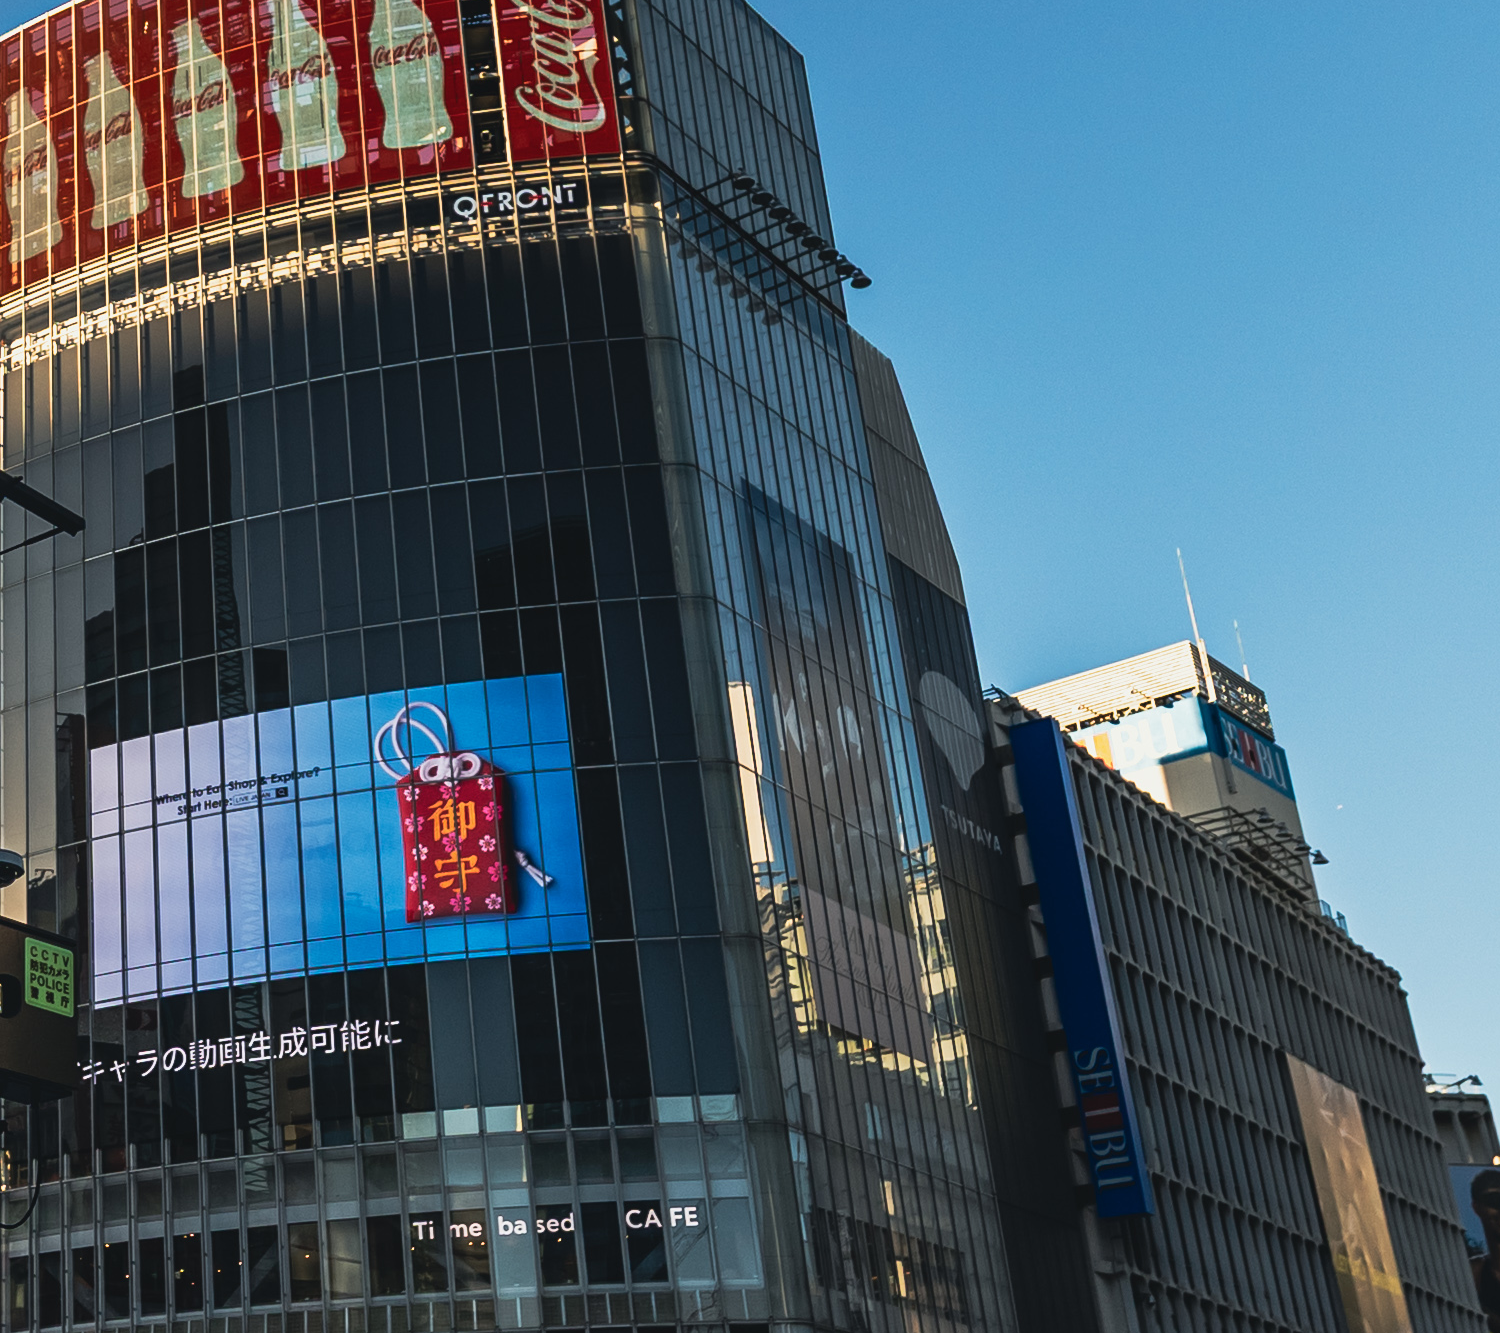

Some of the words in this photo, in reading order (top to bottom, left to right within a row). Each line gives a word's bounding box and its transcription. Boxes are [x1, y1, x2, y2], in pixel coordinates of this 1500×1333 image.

[452, 181, 581, 223] QFRONT
[228, 777, 257, 792] Shop
[29, 945, 70, 968] CCTV
[29, 972, 70, 995] POLICE
[1073, 1046, 1135, 1188] SEIBU
[624, 1206, 700, 1230] CAFE
